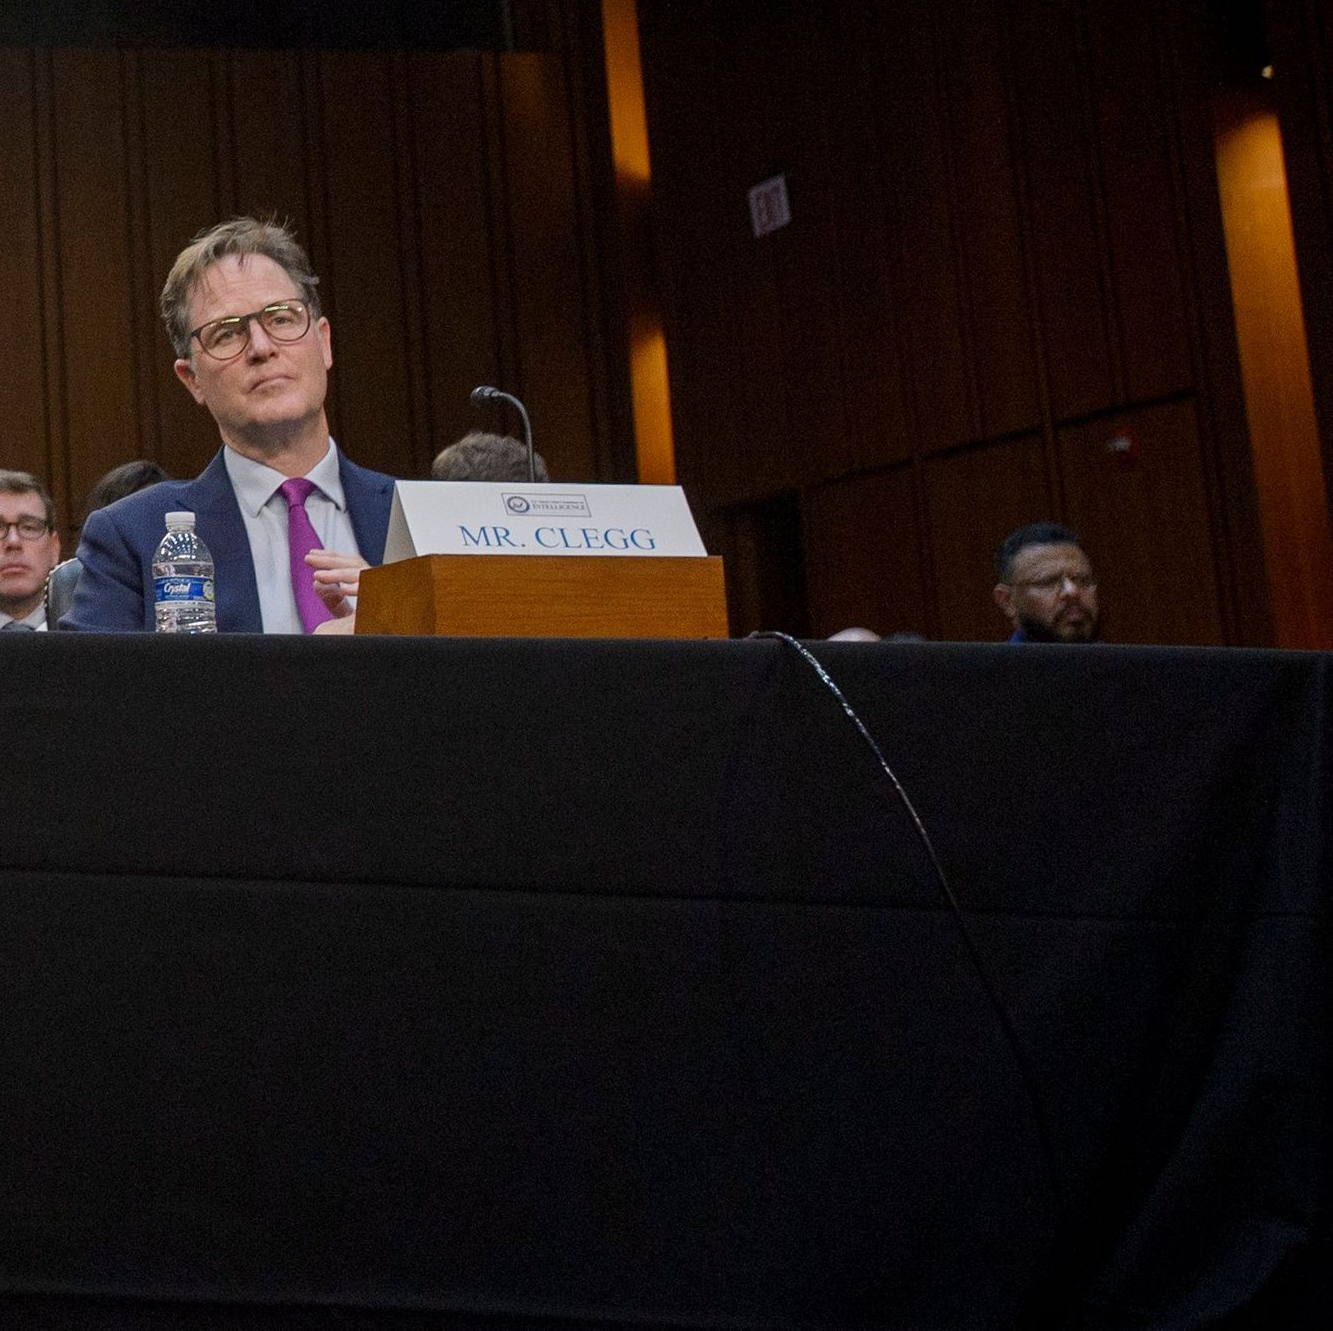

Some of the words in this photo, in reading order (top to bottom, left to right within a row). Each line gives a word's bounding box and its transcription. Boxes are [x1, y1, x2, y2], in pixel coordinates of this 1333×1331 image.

[458, 525, 527, 548] MR.
[535, 526, 657, 551] CLEGG
[163, 582, 192, 595] Crystal
